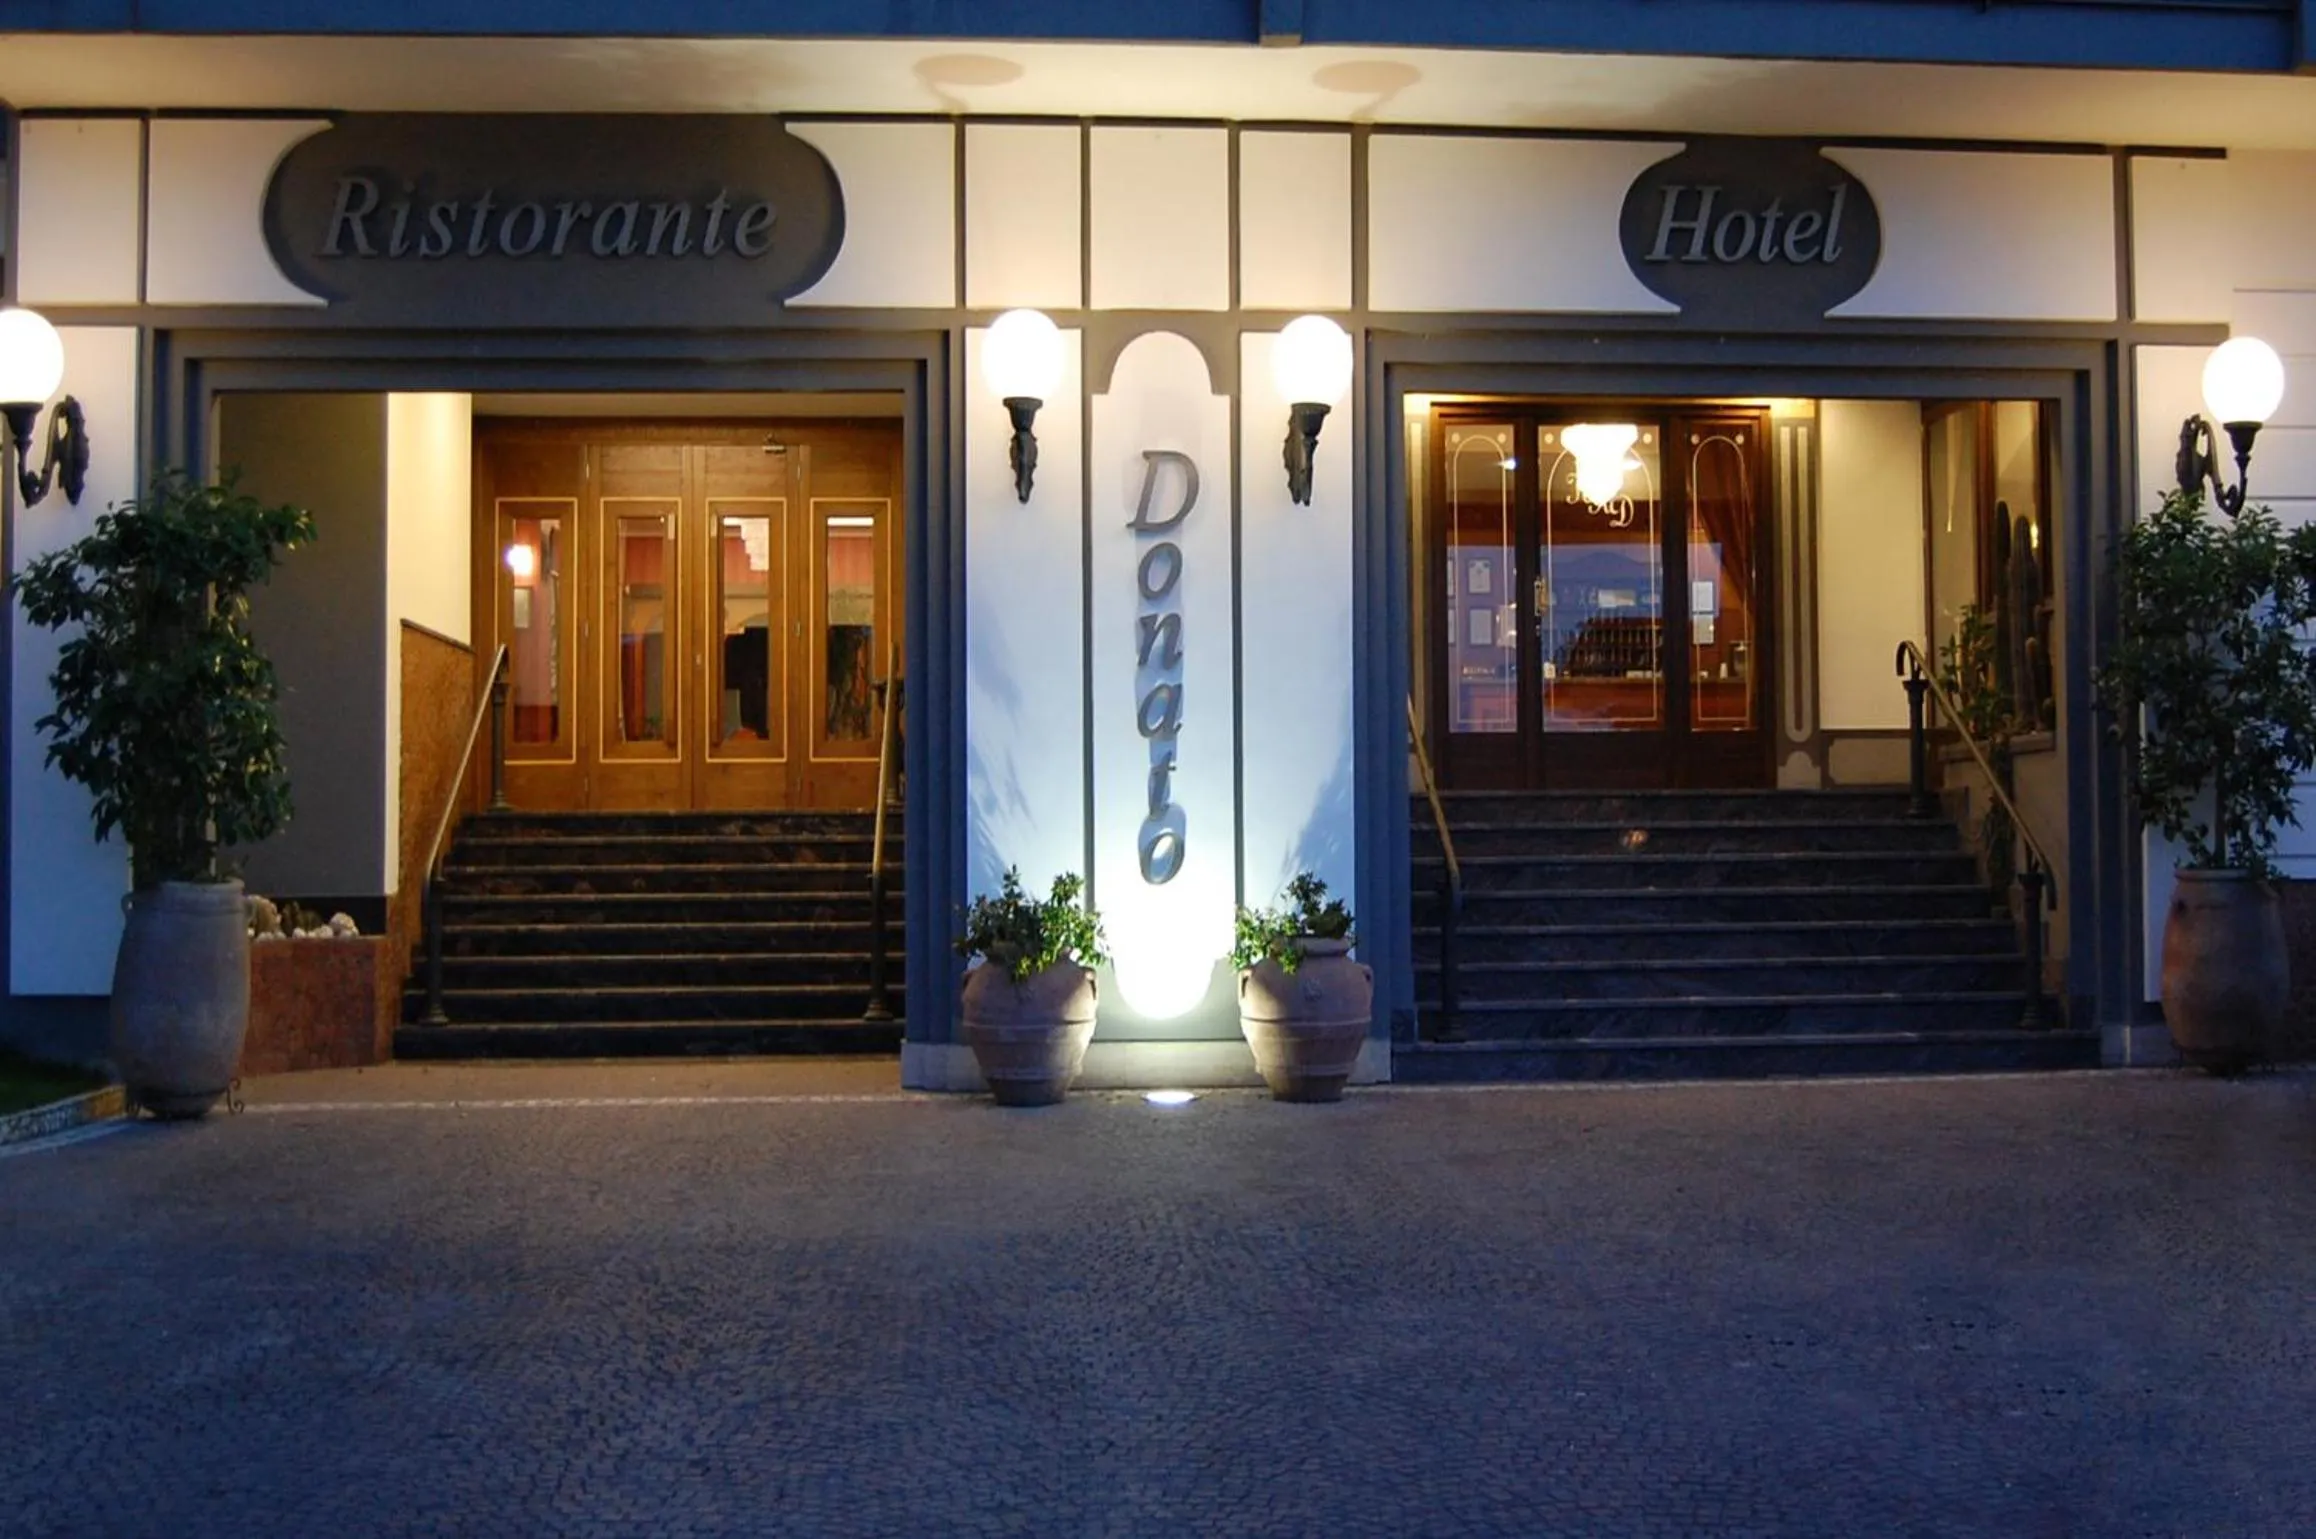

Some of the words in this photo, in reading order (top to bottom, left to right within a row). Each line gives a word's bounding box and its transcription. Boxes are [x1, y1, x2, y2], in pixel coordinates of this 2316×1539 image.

[319, 175, 778, 257] Ristorante
[1644, 183, 1848, 263] Hotel
[1126, 450, 1200, 885] Donato
